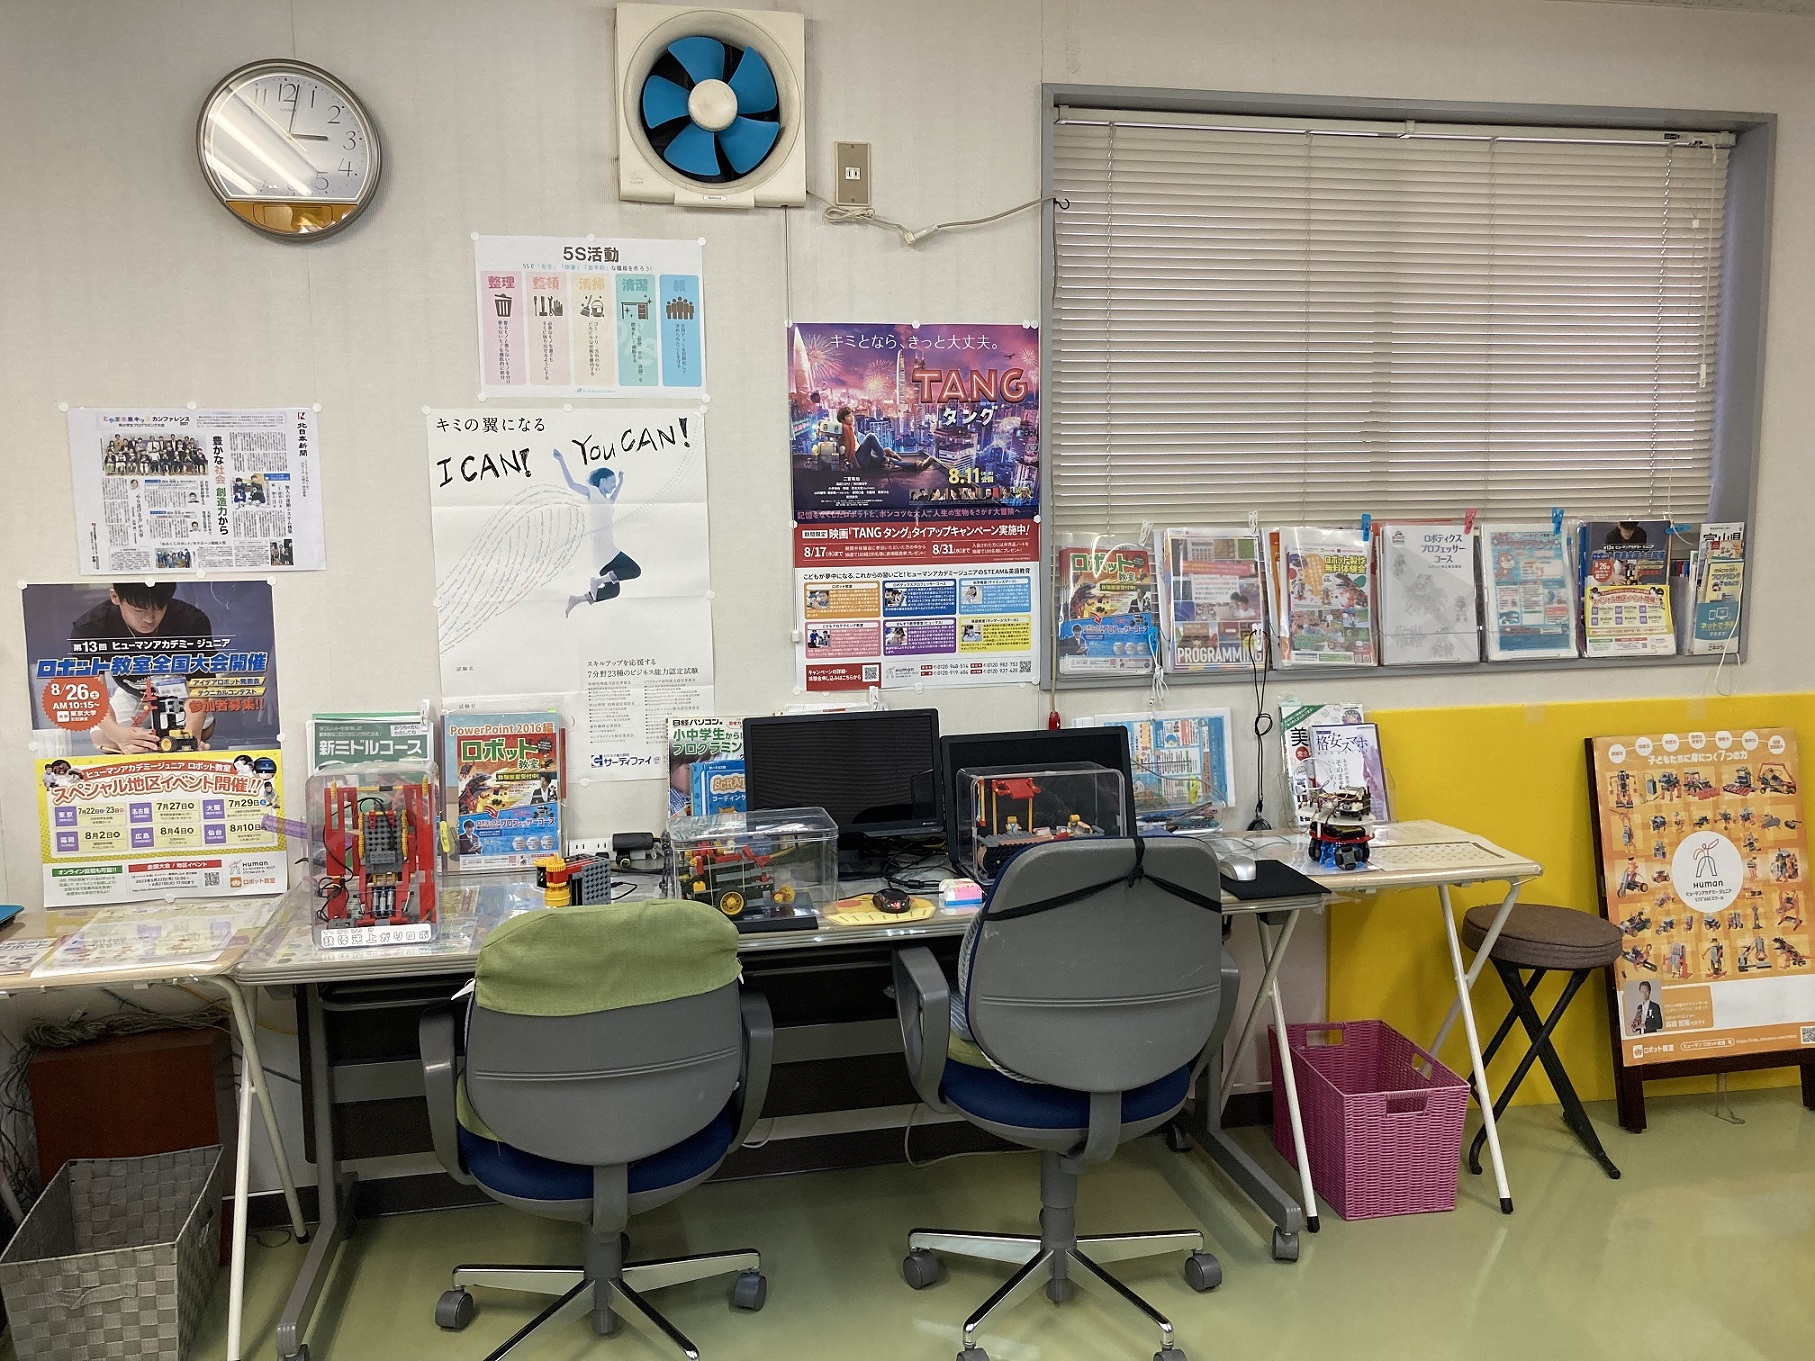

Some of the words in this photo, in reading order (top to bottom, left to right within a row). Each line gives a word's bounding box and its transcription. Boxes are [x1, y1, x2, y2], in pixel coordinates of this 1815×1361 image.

[278, 83, 298, 103] 12
[327, 105, 342, 125] 2
[342, 130, 356, 150] 3
[337, 158, 353, 177] 4
[315, 171, 329, 190] 5
[563, 246, 620, 263] 5S活動
[488, 275, 515, 290] 整理
[532, 276, 560, 290] 整頓
[579, 277, 605, 291] 清掃
[622, 278, 648, 292] 清潔
[830, 334, 998, 350] キミとなら、きっと大丈夫。
[912, 368, 1028, 404] TANG
[942, 405, 998, 426] タング
[436, 417, 545, 433] キミの翼になる
[297, 422, 308, 457] 北日本新聞
[572, 434, 617, 466] You
[620, 417, 691, 453] CAN!
[212, 435, 226, 485] 豊かな社会
[436, 456, 453, 487] I
[460, 447, 532, 482] CAN!
[948, 467, 980, 484] 8.11
[215, 487, 229, 536] 創造力から
[1424, 534, 1463, 543] ロボティクス
[1421, 545, 1466, 553] プロフェッサー
[1434, 555, 1453, 563] コース
[73, 641, 107, 653] 第13回
[111, 640, 194, 651] ヒューマンアカデミー
[196, 638, 230, 649] ジュニア
[37, 652, 269, 678] ロボット教室全国大会開催
[587, 658, 656, 667] スキルアップを応援する
[587, 667, 699, 678] 7分野23種のビジネス能力認定試験
[51, 683, 89, 700] 8/26
[197, 688, 257, 697] テクニカルコンテスト
[450, 725, 514, 736] PowerPoint
[516, 722, 554, 735] 2016編
[672, 718, 720, 726] 日経パソコン
[319, 739, 422, 756] 新ミドルコース
[461, 737, 538, 762] ロボット
[1315, 732, 1368, 752] 格安スマホ
[518, 758, 540, 770] 教室
[604, 756, 652, 767] サーティファイ
[1648, 749, 1748, 765] 子どもたちに身につく7つの力
[86, 762, 185, 779] ヒューマンアカデミージュニア
[187, 763, 232, 772] ロボット教室
[53, 775, 262, 802] スペシャル地区イベント開催!!
[132, 807, 150, 815] 名古屋
[156, 802, 187, 811] 7月27日
[228, 799, 259, 808] 7月29日
[85, 831, 113, 839] 8月2日
[160, 827, 187, 835] 8月4日
[1693, 880, 1724, 888] Human
[1643, 1044, 1675, 1053] ロボット教室
